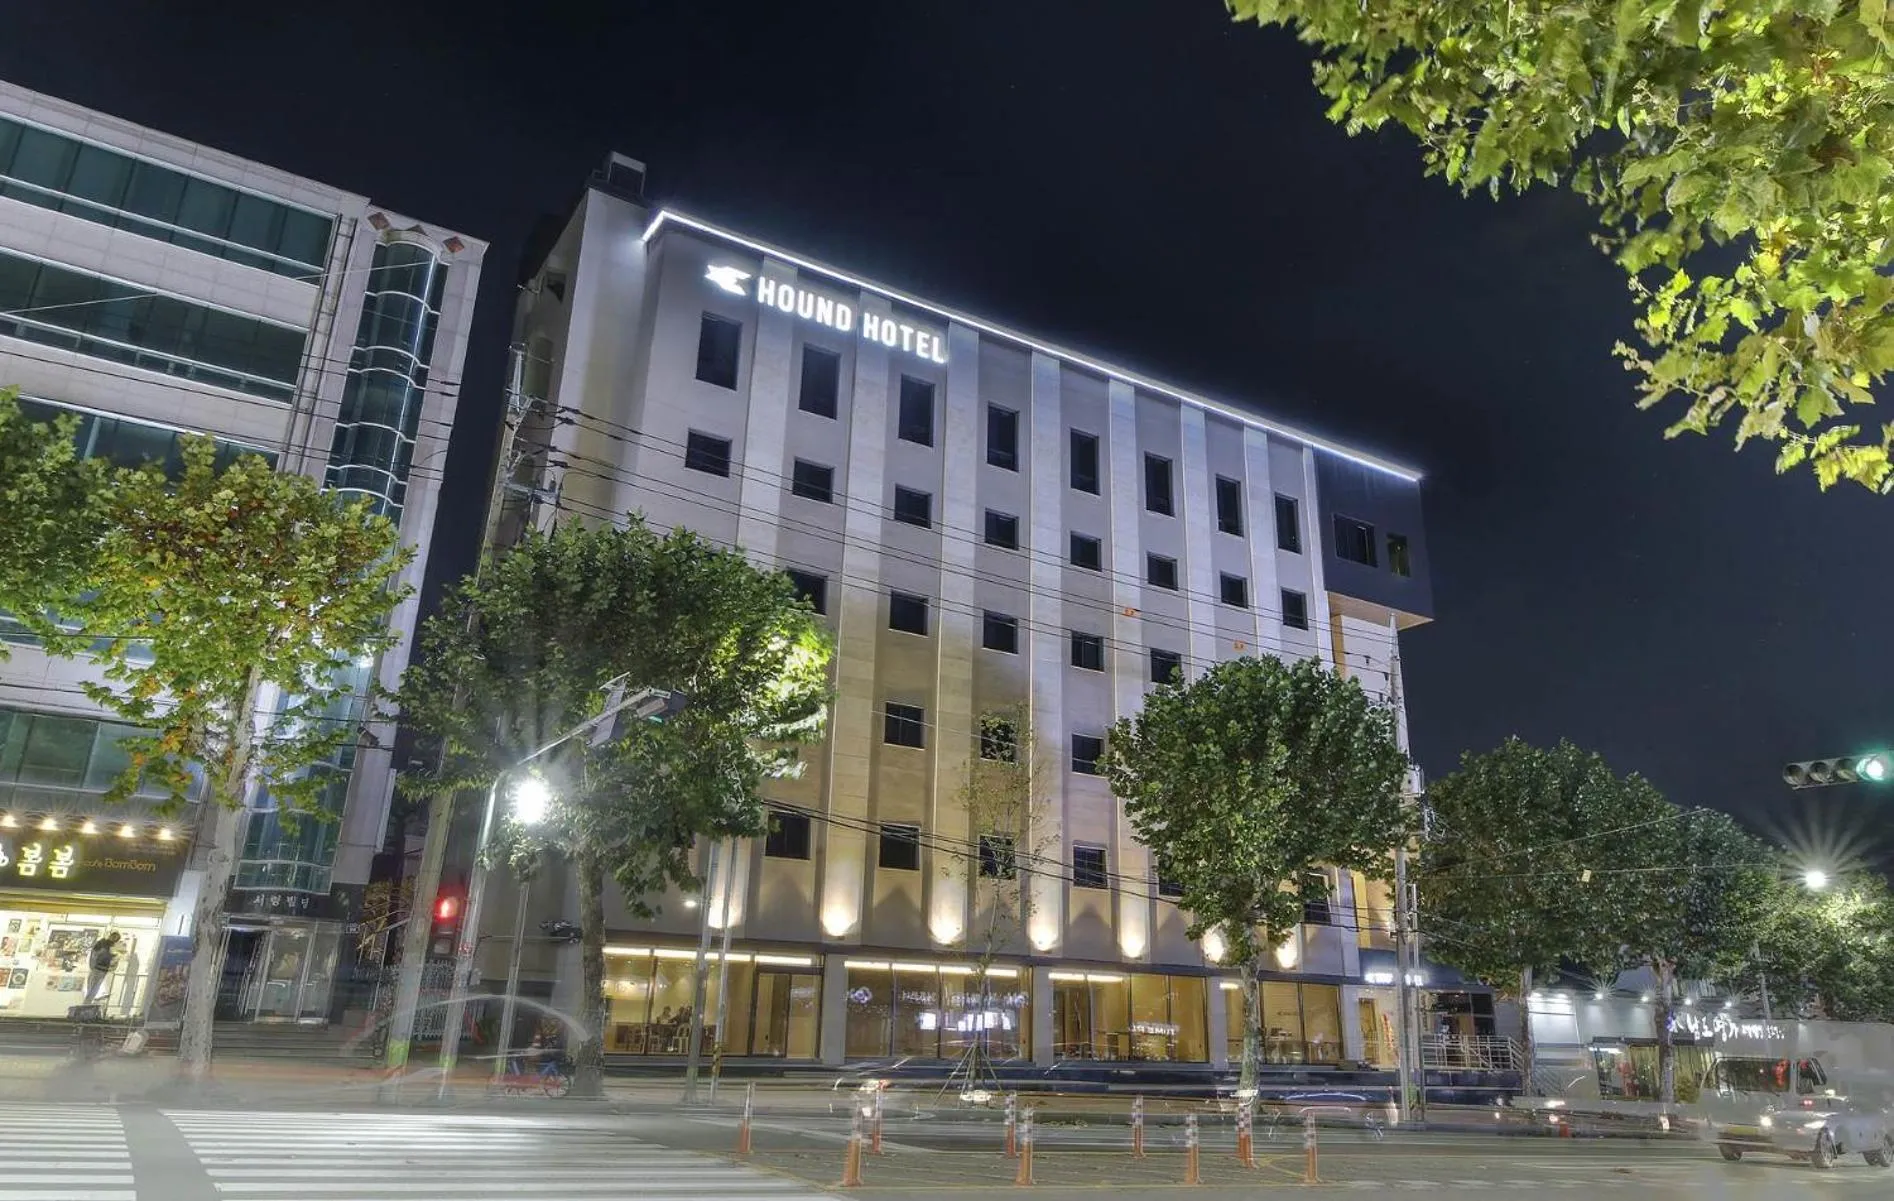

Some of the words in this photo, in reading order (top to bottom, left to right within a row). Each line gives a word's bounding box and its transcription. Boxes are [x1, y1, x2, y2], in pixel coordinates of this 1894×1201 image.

[757, 276, 852, 332] HOUND
[863, 312, 947, 364] HOTEL
[16, 843, 74, 879] 봄봄
